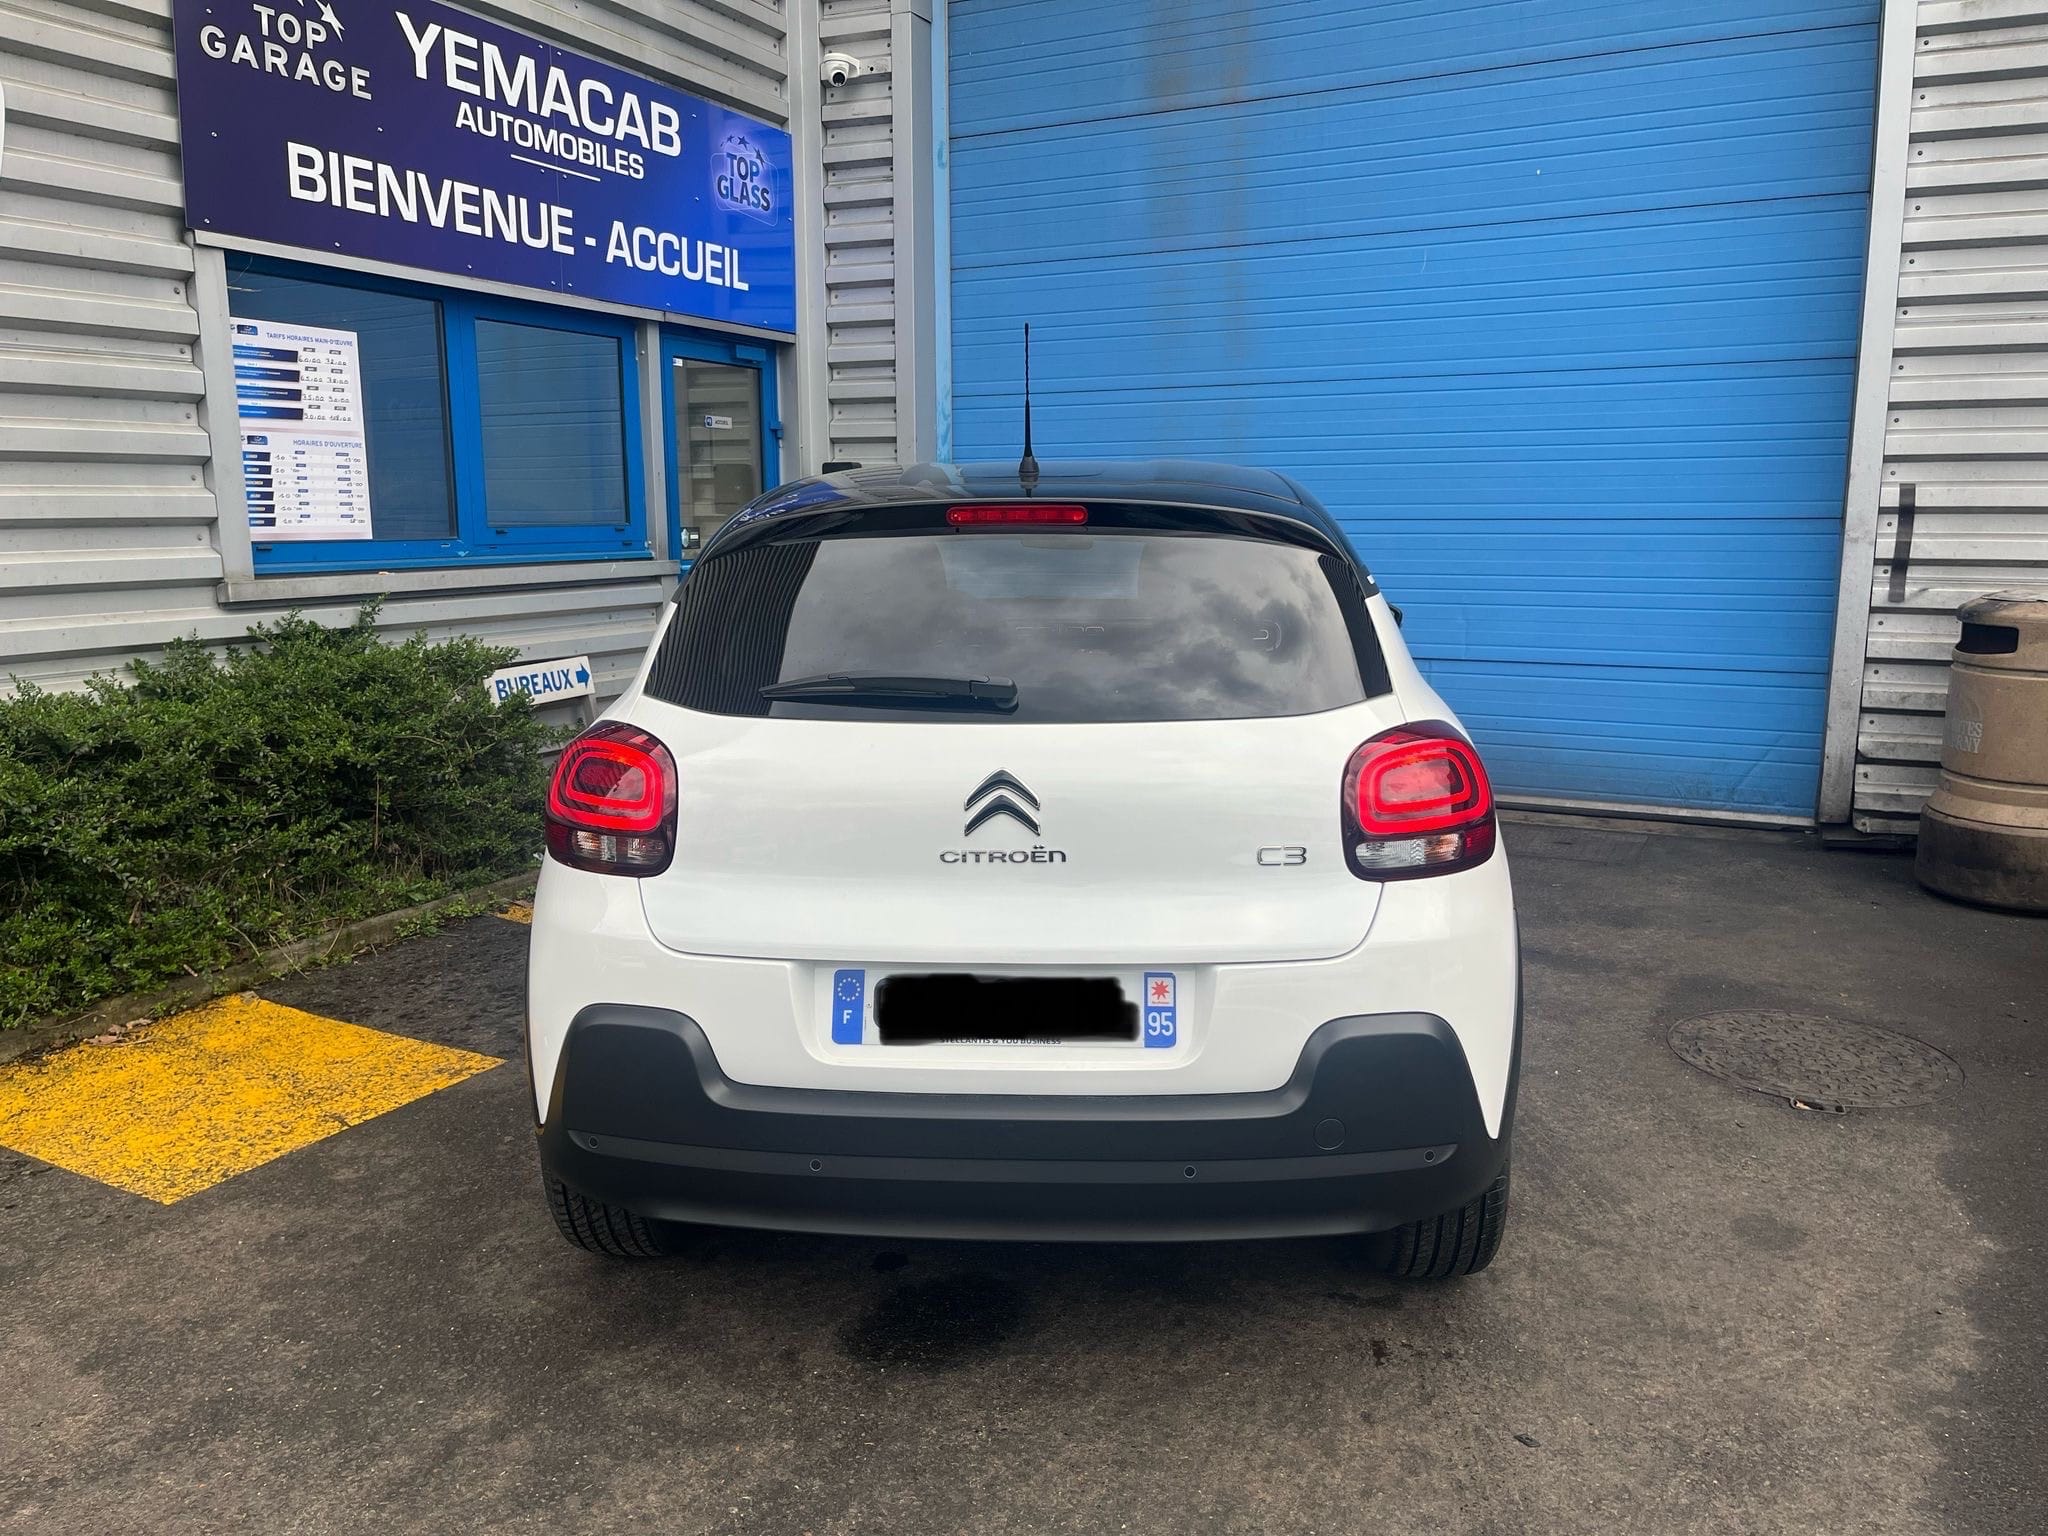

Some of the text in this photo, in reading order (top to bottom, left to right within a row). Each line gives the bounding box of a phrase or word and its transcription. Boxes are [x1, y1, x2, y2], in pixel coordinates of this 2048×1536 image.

[253, 4, 327, 49] TOP
[200, 25, 372, 100] GARAGE
[395, 11, 681, 157] YEMACAB
[455, 101, 645, 180] AUTOMOBILES
[726, 152, 760, 183] TOP
[717, 174, 771, 212] GLASS
[287, 141, 575, 255] BIENVENUE
[606, 220, 749, 291] ACCUEIL
[938, 844, 1067, 864] CITROËN
[1256, 845, 1307, 866] C3
[843, 1010, 852, 1024] F
[1147, 1011, 1174, 1036] 95
